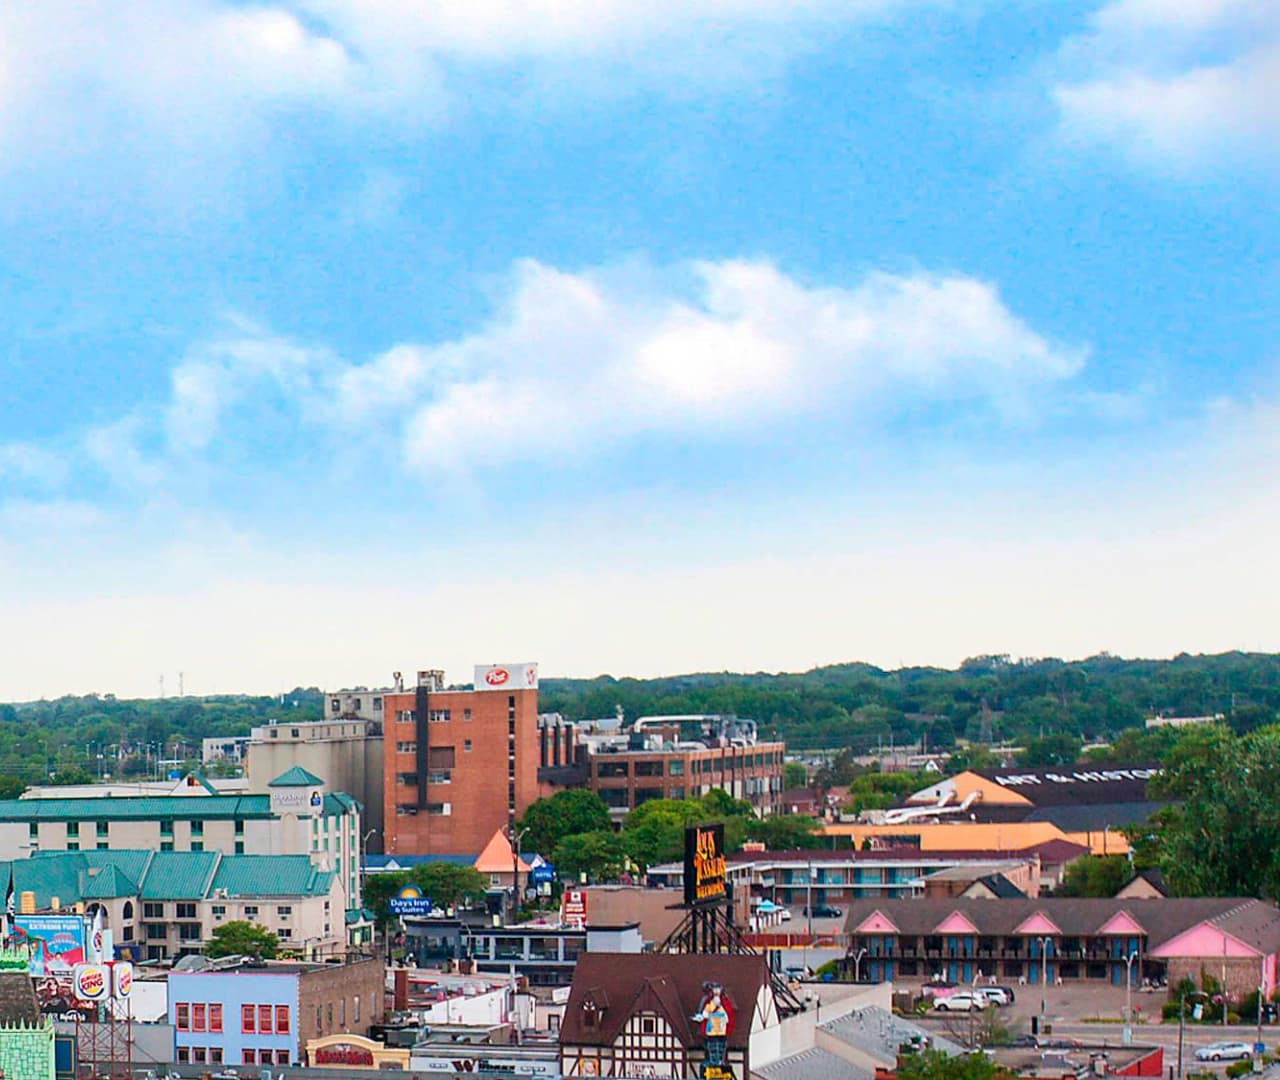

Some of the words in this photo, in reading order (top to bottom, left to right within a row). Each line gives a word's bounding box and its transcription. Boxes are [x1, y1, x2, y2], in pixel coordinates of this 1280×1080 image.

[390, 899, 412, 908] Days
[414, 899, 430, 907] Inn
[82, 979, 104, 990] KING
